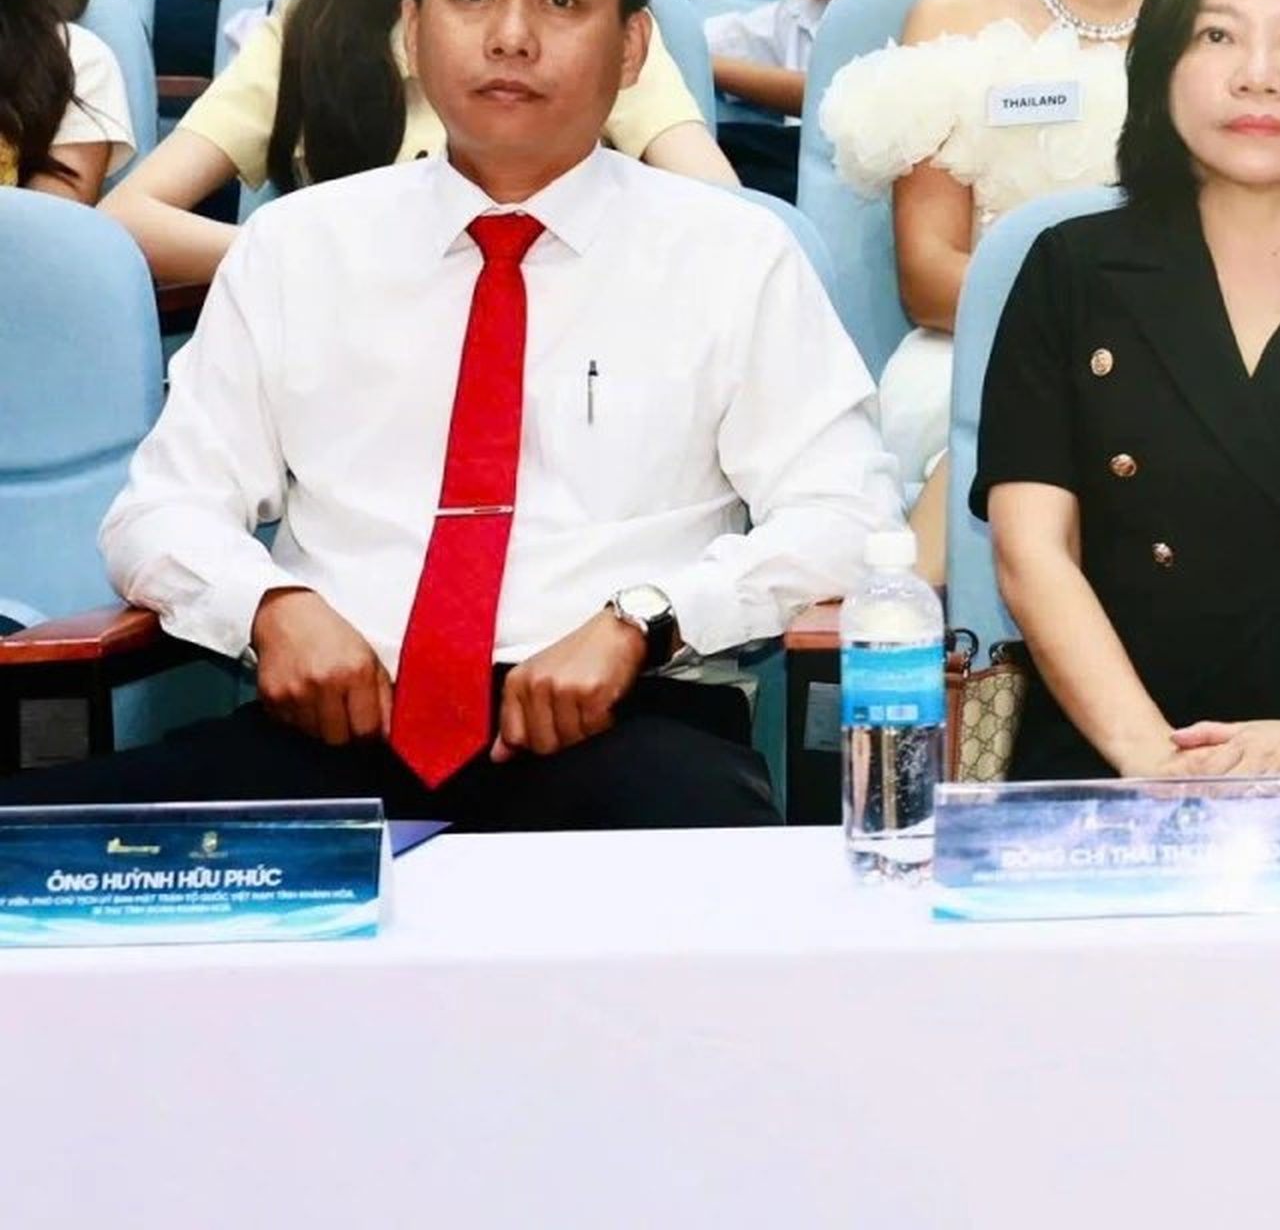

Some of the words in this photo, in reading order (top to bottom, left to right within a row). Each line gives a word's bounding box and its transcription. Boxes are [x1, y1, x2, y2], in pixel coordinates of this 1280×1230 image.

[1002, 94, 1067, 108] THAILAND
[47, 870, 99, 891] ÔNG
[101, 868, 174, 890] HUỲNH
[178, 866, 220, 888] HỮU
[224, 864, 282, 887] PHÚC
